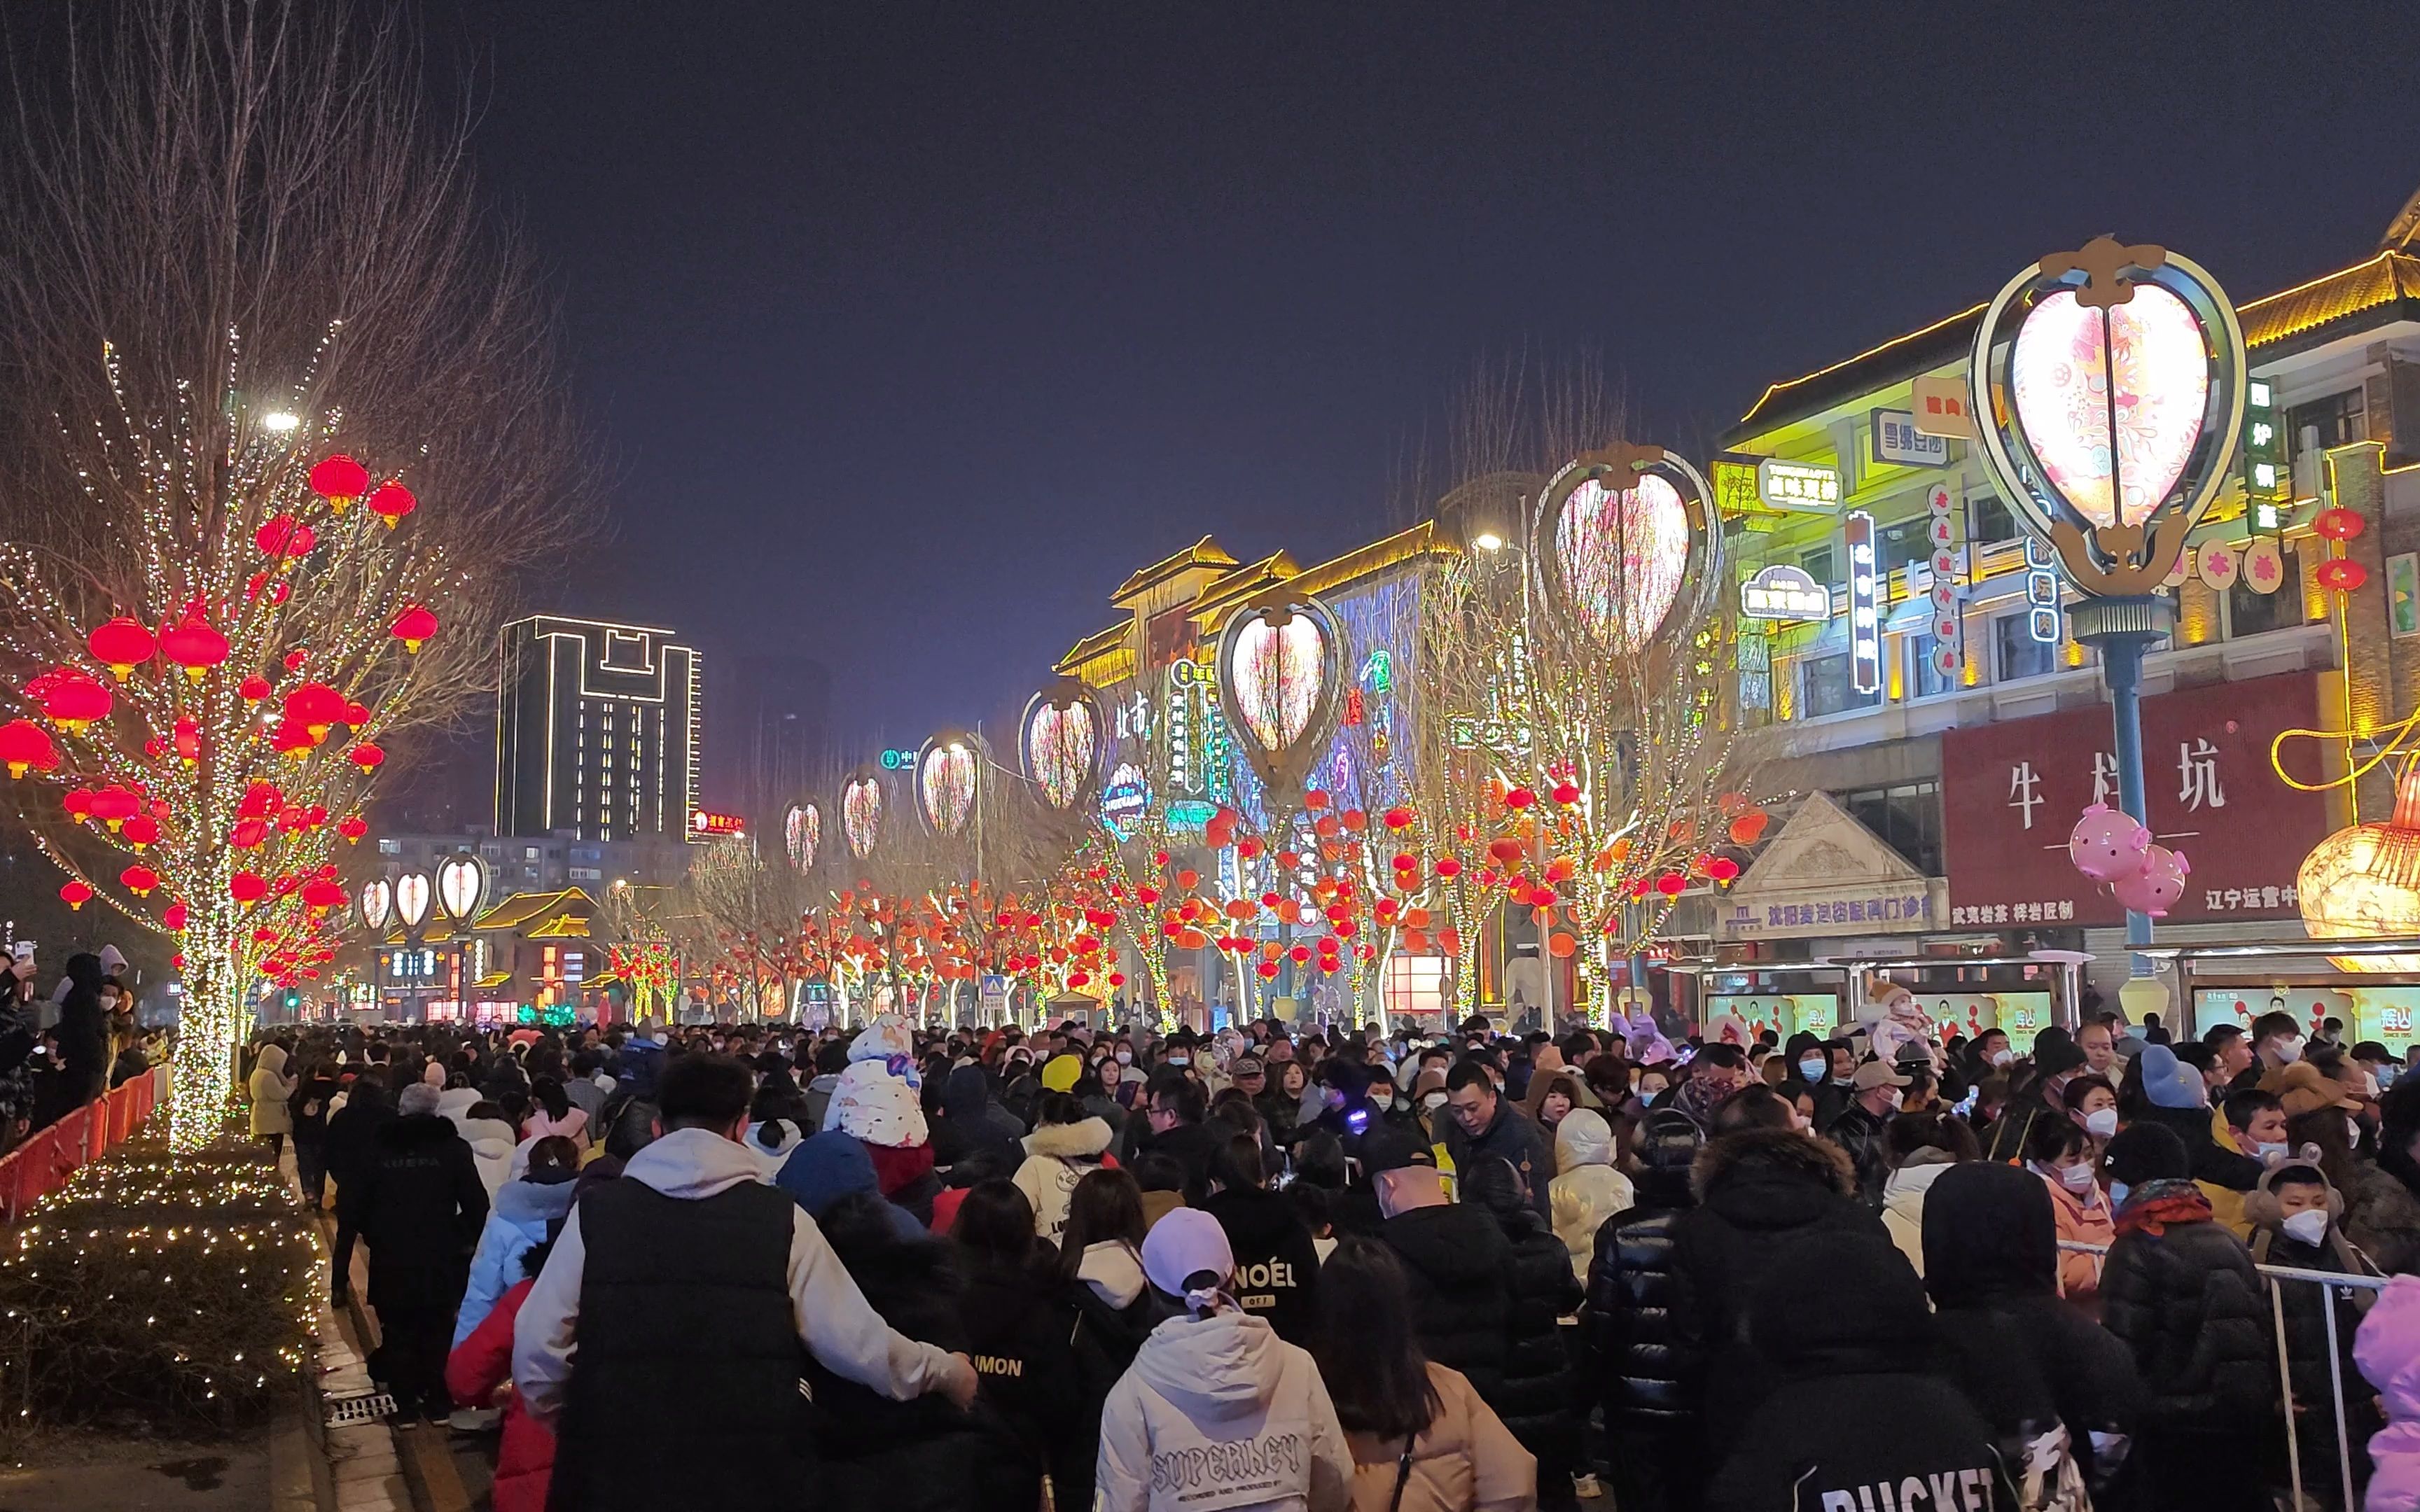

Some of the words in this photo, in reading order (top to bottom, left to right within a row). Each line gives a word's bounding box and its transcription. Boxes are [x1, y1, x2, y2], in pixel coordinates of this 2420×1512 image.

[1935, 491, 1954, 668] 老友谊冷面店
[1952, 904, 2008, 925] 武夷岩茶
